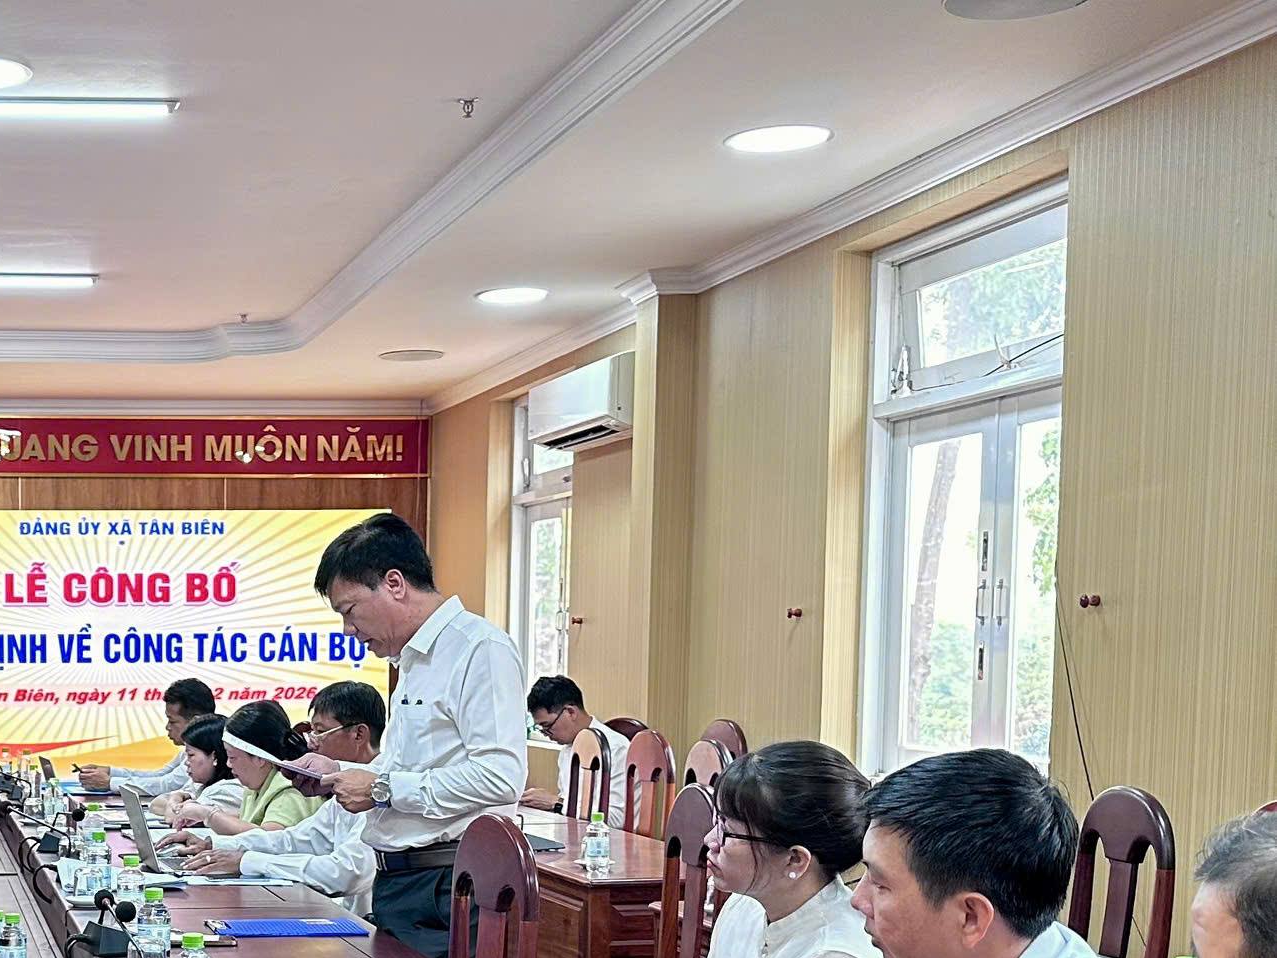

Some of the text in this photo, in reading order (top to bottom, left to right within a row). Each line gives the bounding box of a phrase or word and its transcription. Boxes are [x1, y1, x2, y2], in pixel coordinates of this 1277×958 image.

[110, 434, 192, 462] VINH
[204, 425, 307, 463] MUÔN
[317, 426, 403, 462] NĂM!
[19, 517, 71, 535] ĐẢNG
[78, 517, 101, 535] ỦY
[139, 518, 175, 535] TÂN
[181, 518, 225, 535] BIÊN
[4, 561, 239, 604] LỄ CÔNG BỐ
[57, 623, 93, 664] VỀ
[103, 626, 184, 664] CÔNG
[193, 626, 248, 663] TÁC
[258, 625, 318, 662] CÁN
[13, 687, 60, 705] Biên,
[66, 688, 113, 705] ngày
[116, 687, 138, 701] 11
[228, 686, 267, 700] năm
[274, 686, 318, 700] 2026
